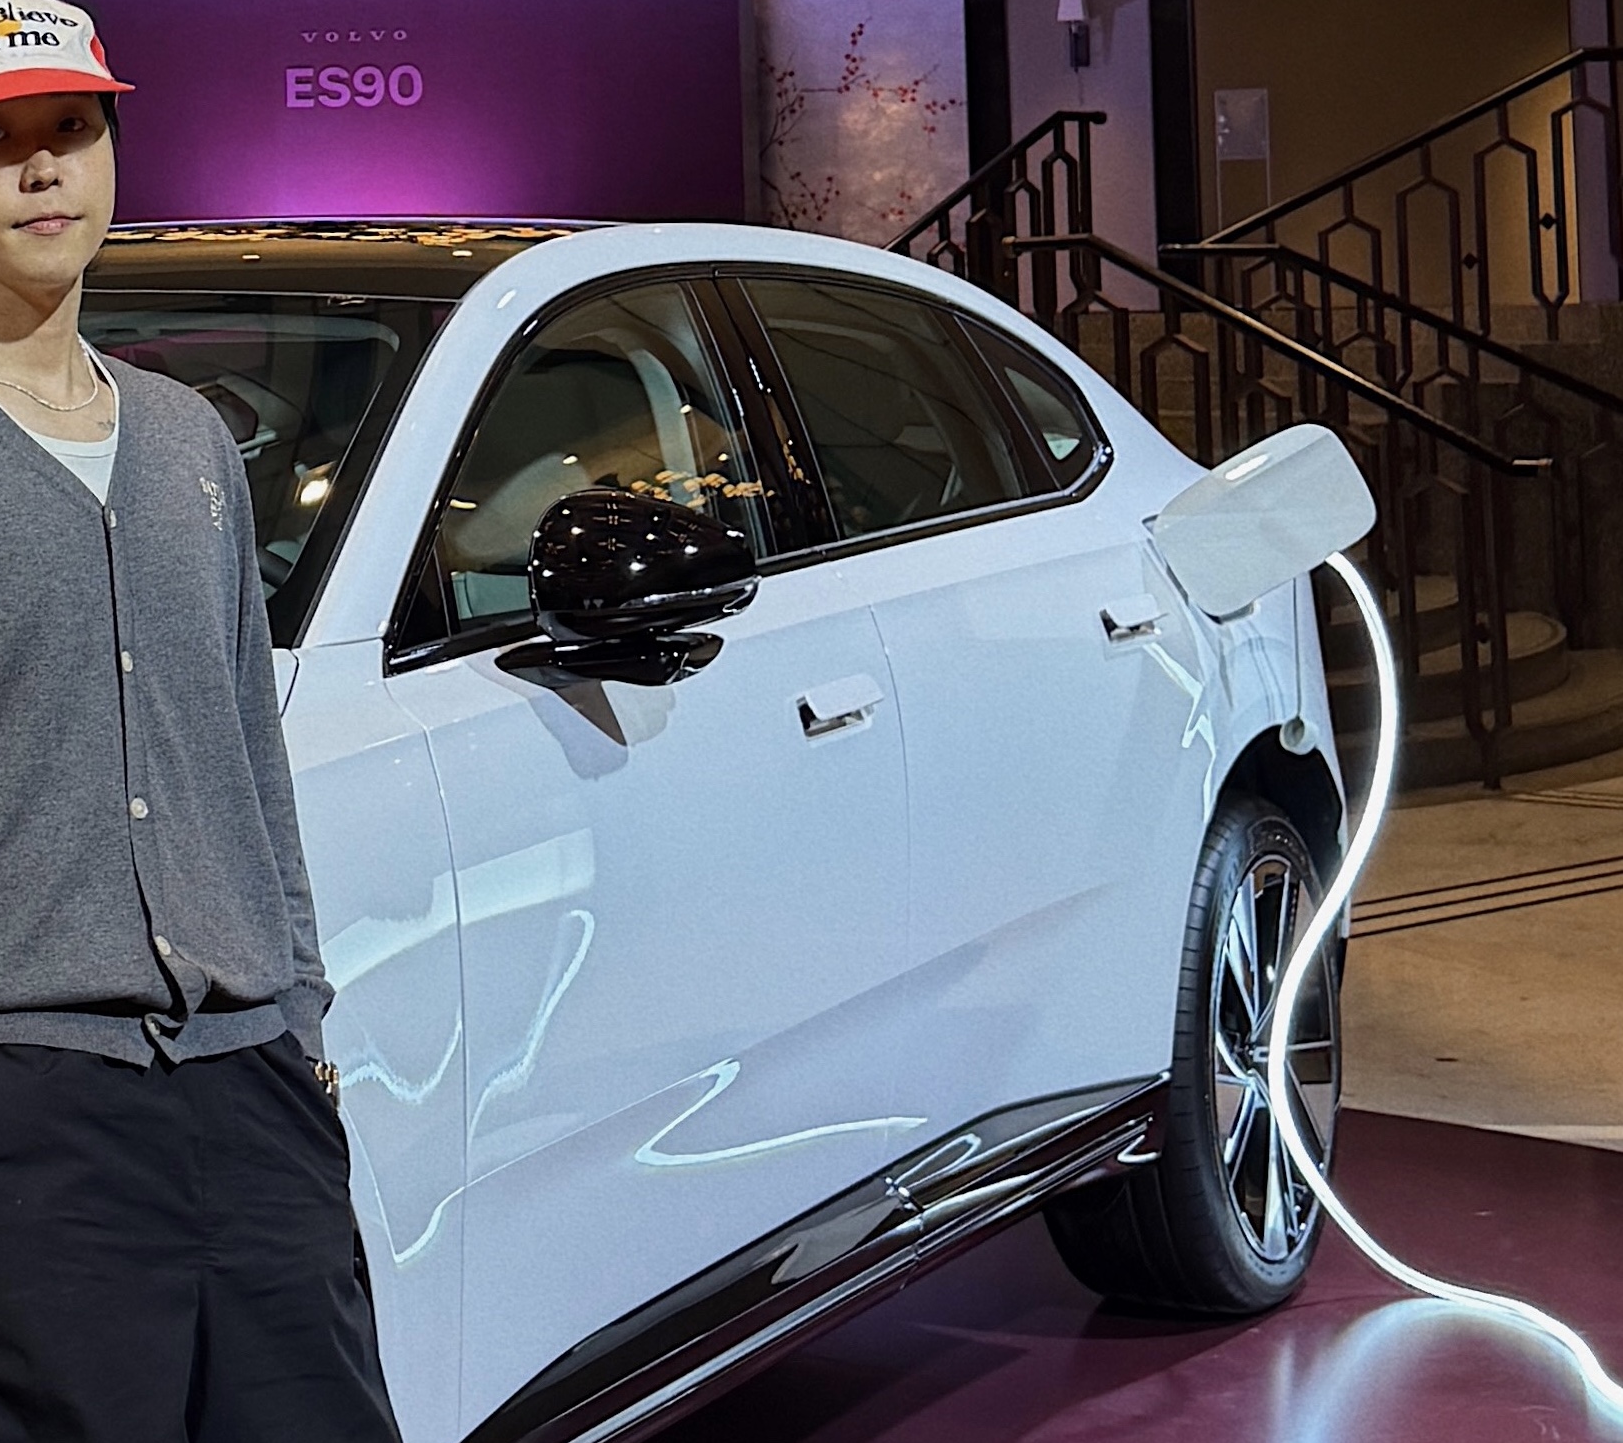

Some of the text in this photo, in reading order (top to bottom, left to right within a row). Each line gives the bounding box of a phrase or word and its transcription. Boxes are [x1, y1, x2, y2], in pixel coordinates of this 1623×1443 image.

[7, 31, 60, 48] me
[301, 29, 407, 43] VOLVO
[285, 65, 423, 108] ES90
